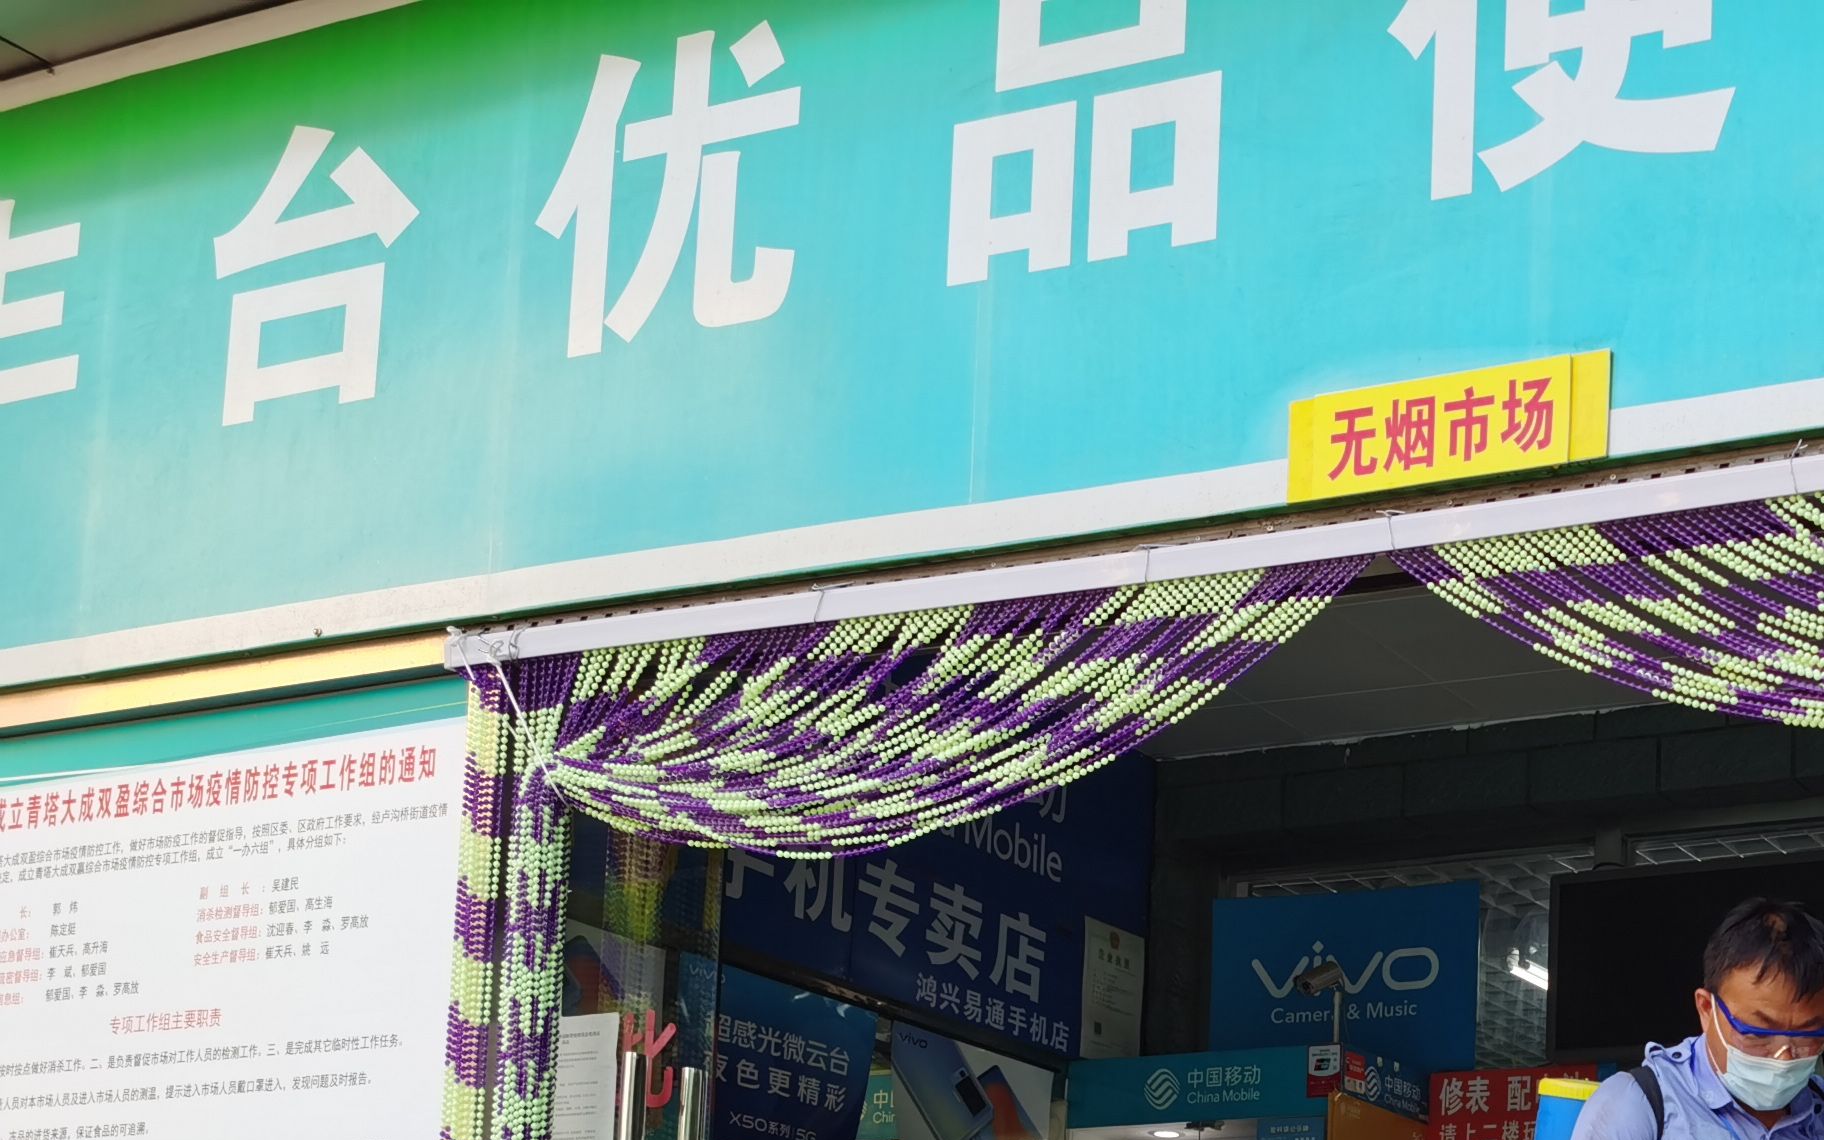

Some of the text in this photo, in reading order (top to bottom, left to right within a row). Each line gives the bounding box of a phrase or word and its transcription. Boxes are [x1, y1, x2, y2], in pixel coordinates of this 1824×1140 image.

[1328, 376, 1556, 483] 无烟市场
[964, 819, 1063, 882] Mobile
[1251, 941, 1440, 998] vivo
[110, 1008, 222, 1036] 专项工作组主要职责
[916, 972, 1071, 1053] 鸿兴易通手机店
[1347, 1003, 1360, 1019] &
[1367, 1000, 1418, 1019] Music
[898, 1031, 928, 1049] vivo
[1186, 1064, 1262, 1089] 中国移动
[1187, 1087, 1261, 1105] China Mobile
[1439, 1075, 1490, 1117] 修表
[728, 1111, 790, 1138] X50系列
